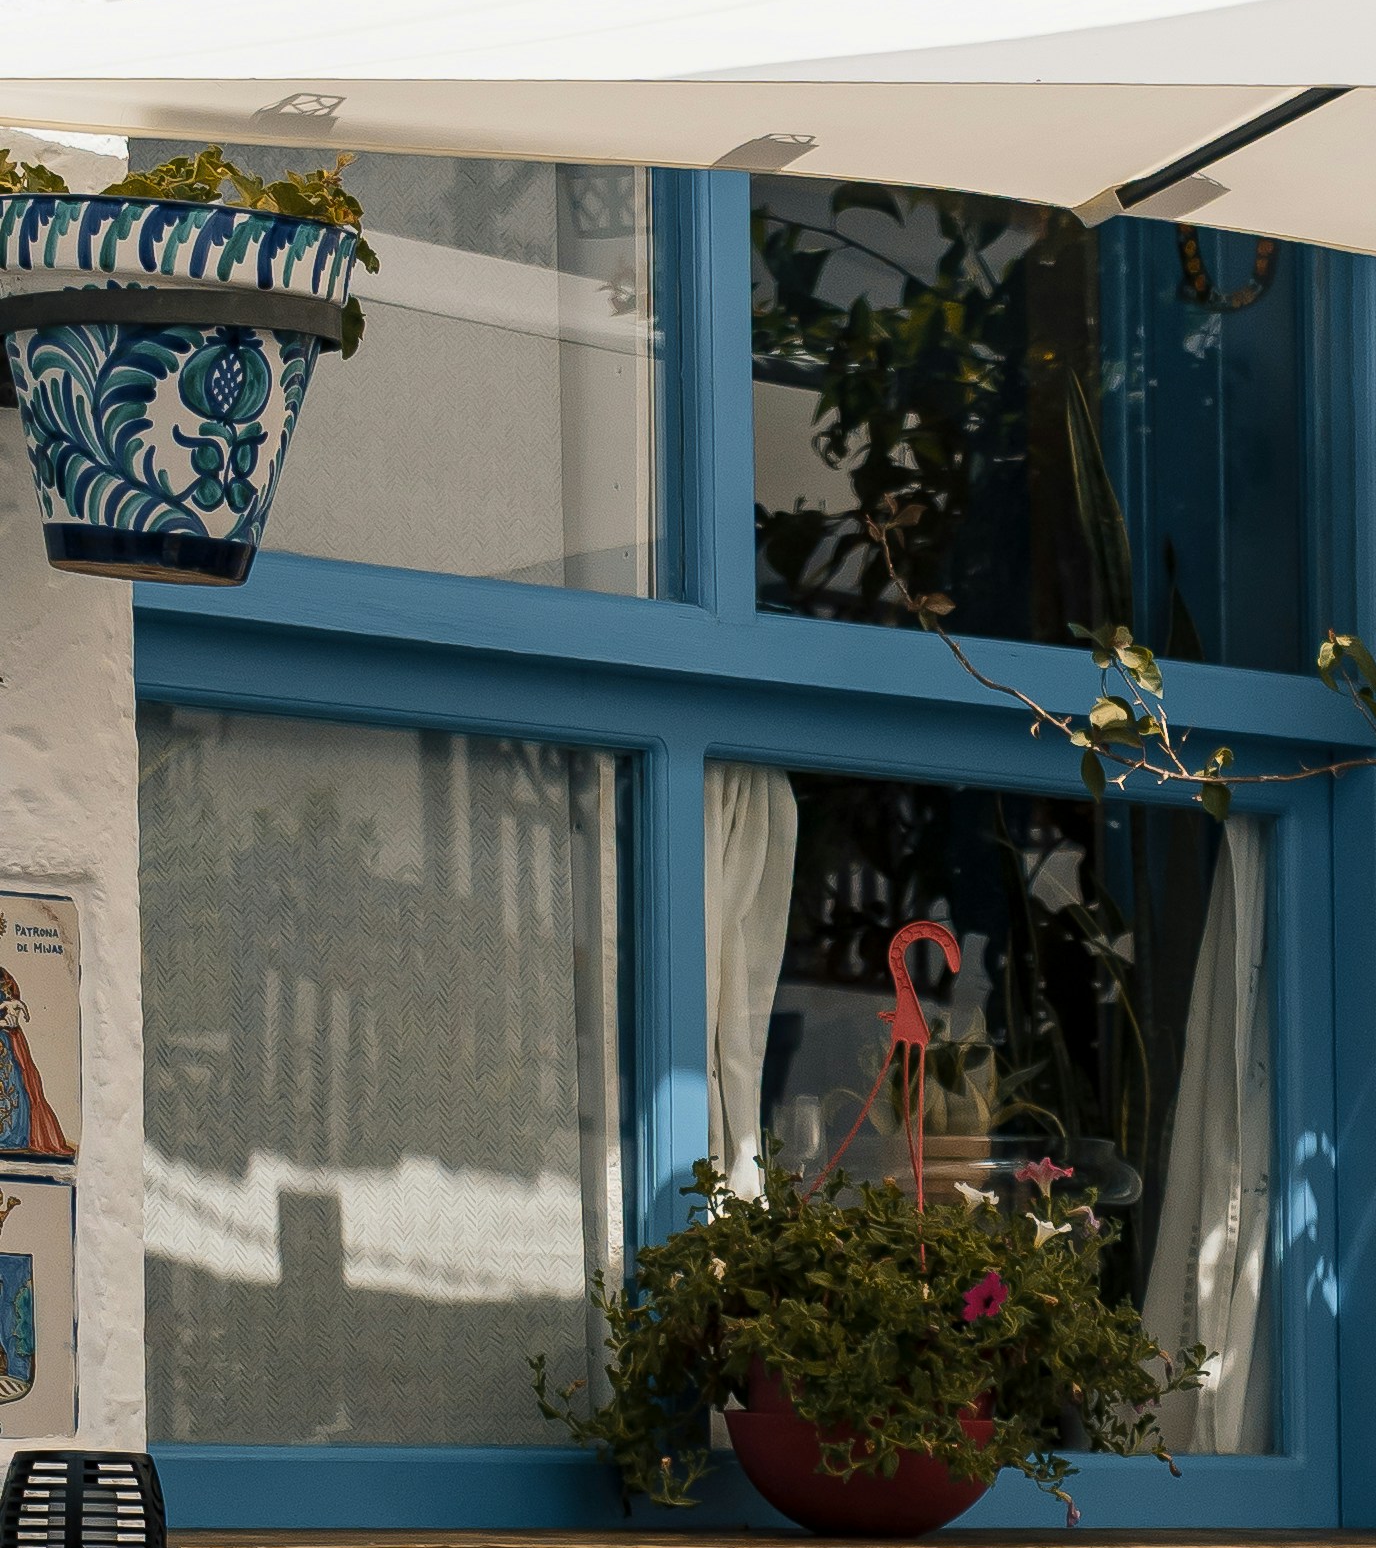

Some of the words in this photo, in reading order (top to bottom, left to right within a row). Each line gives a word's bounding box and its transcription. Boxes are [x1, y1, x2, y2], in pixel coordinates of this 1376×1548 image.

[15, 924, 59, 939] PATRONA
[17, 943, 29, 953] DE
[34, 943, 63, 955] MIJAS
